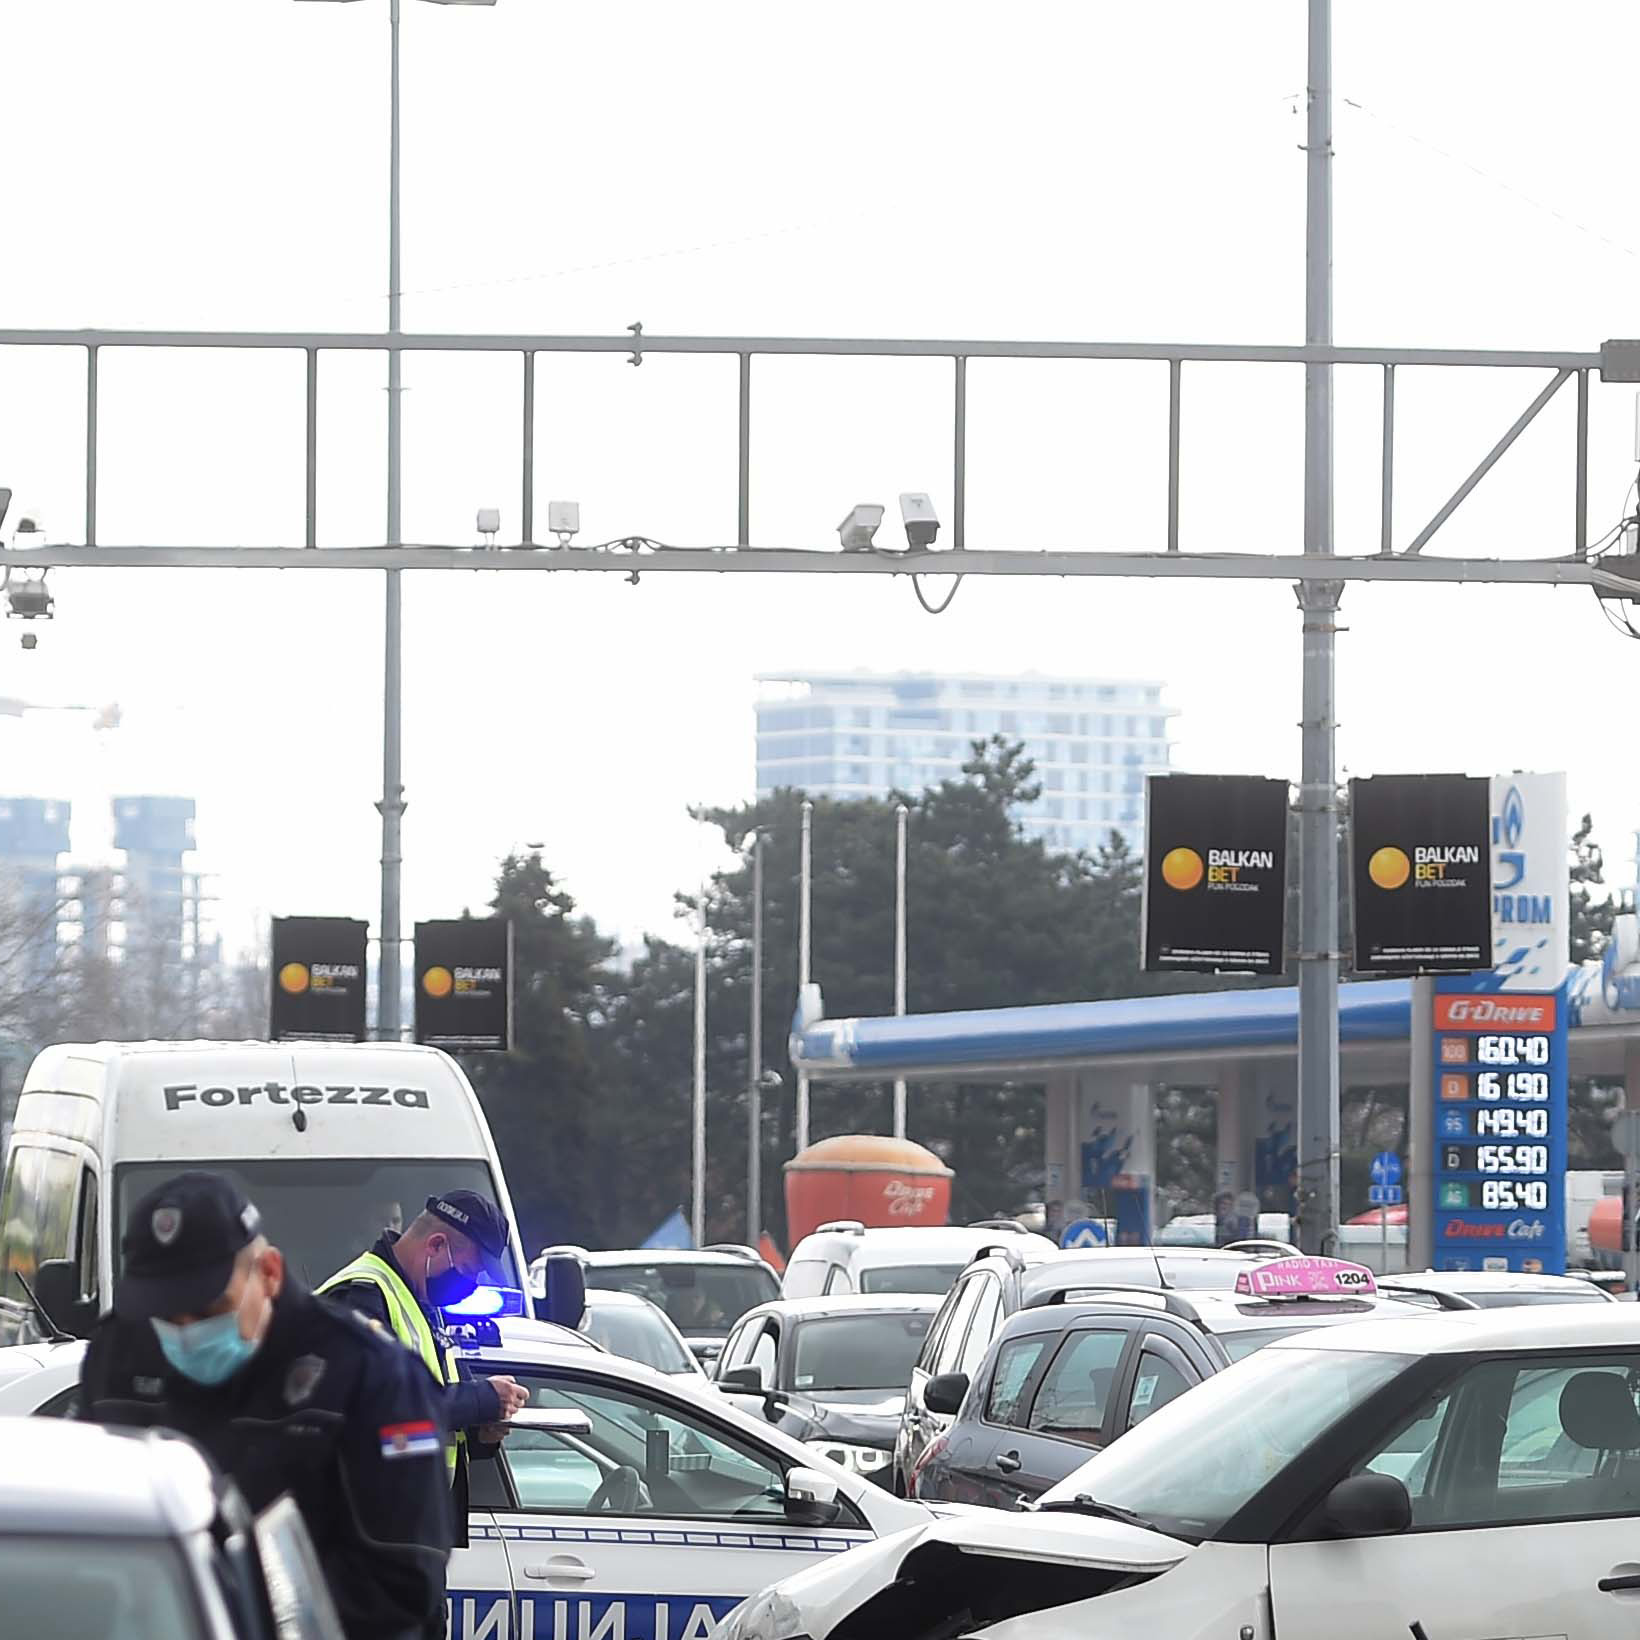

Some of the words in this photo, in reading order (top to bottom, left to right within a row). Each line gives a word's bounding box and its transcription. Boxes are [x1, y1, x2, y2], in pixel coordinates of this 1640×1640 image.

[1208, 849, 1273, 868] BALKAN
[1415, 846, 1479, 863] BALKAN
[1208, 866, 1240, 882] BET
[1415, 863, 1446, 880] BET
[163, 1080, 430, 1111] Fortezza
[1448, 1153, 1460, 1168] D
[1256, 1271, 1303, 1292] PINK
[1335, 1273, 1371, 1285] 1204
